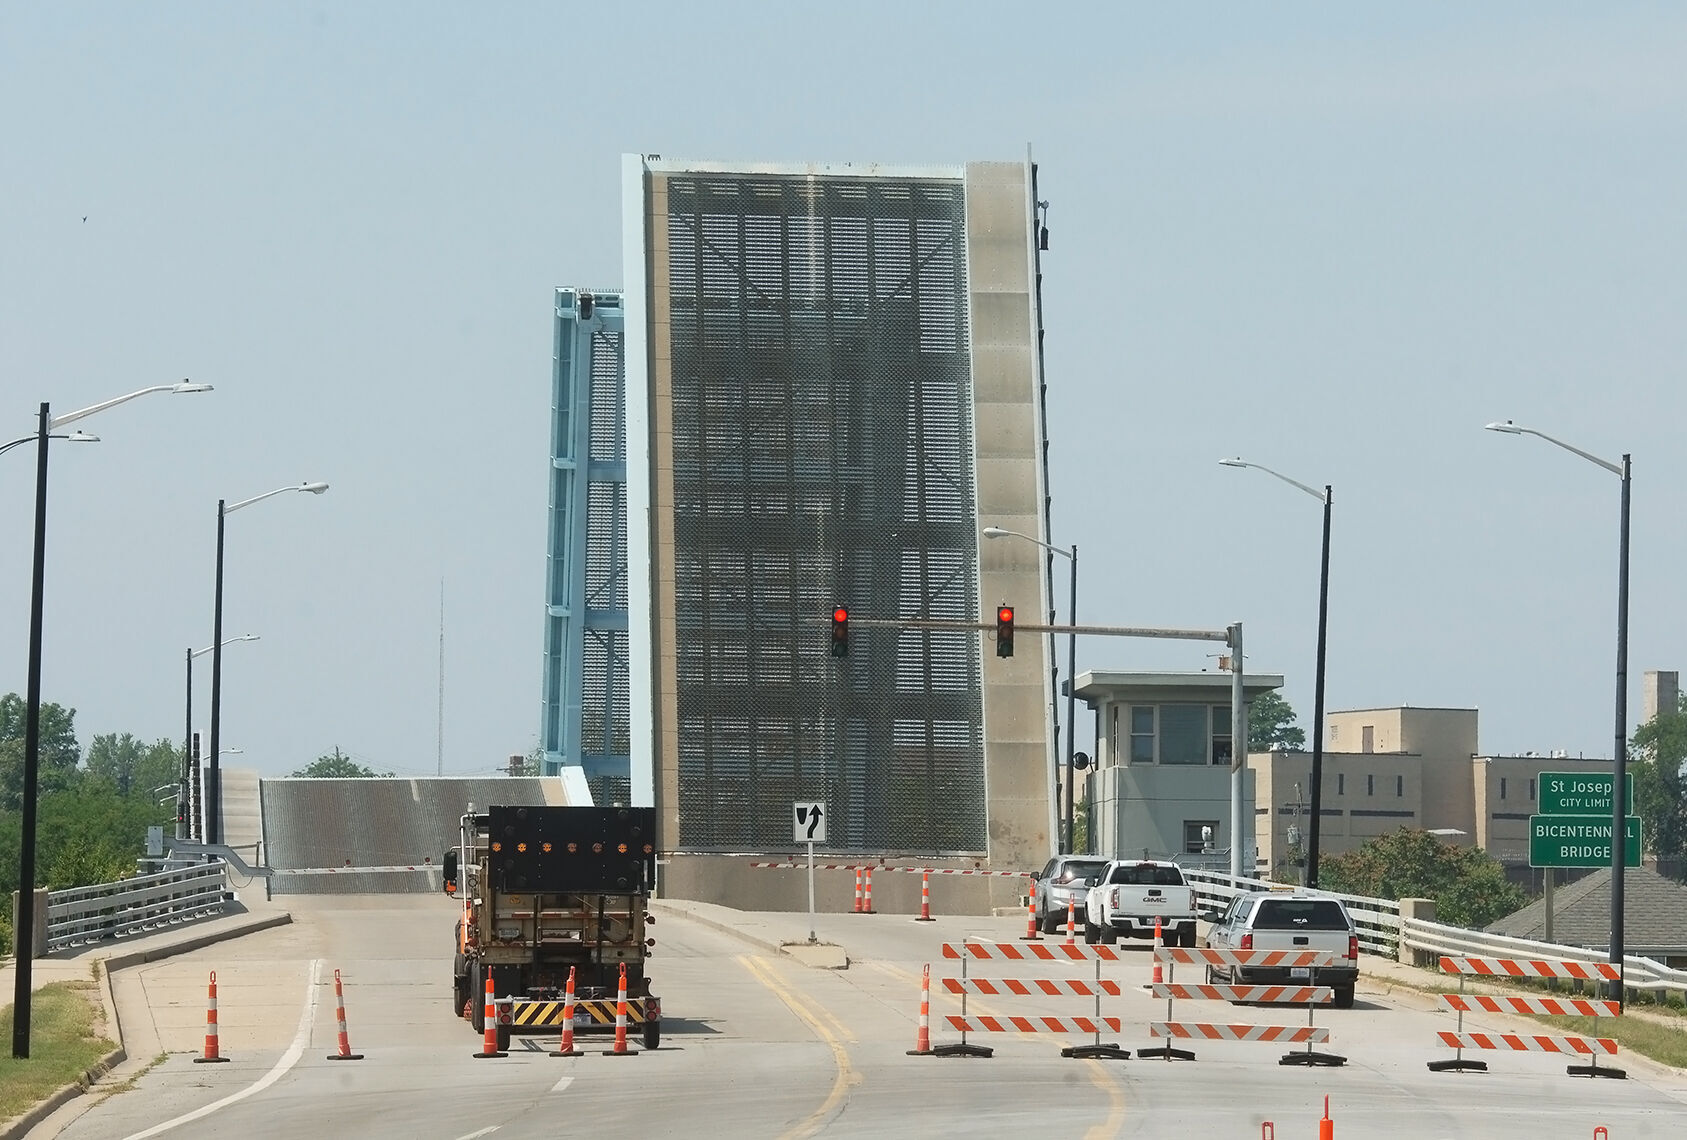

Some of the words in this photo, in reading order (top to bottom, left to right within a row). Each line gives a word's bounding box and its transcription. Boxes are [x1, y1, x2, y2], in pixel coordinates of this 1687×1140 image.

[1550, 780, 1565, 793] St
[1570, 781, 1614, 796] Josep
[1559, 798, 1581, 807] CITY
[1584, 798, 1611, 808] LIMIT
[1536, 825, 1634, 838] BICENTENNL
[1560, 846, 1611, 858] BRIDGE
